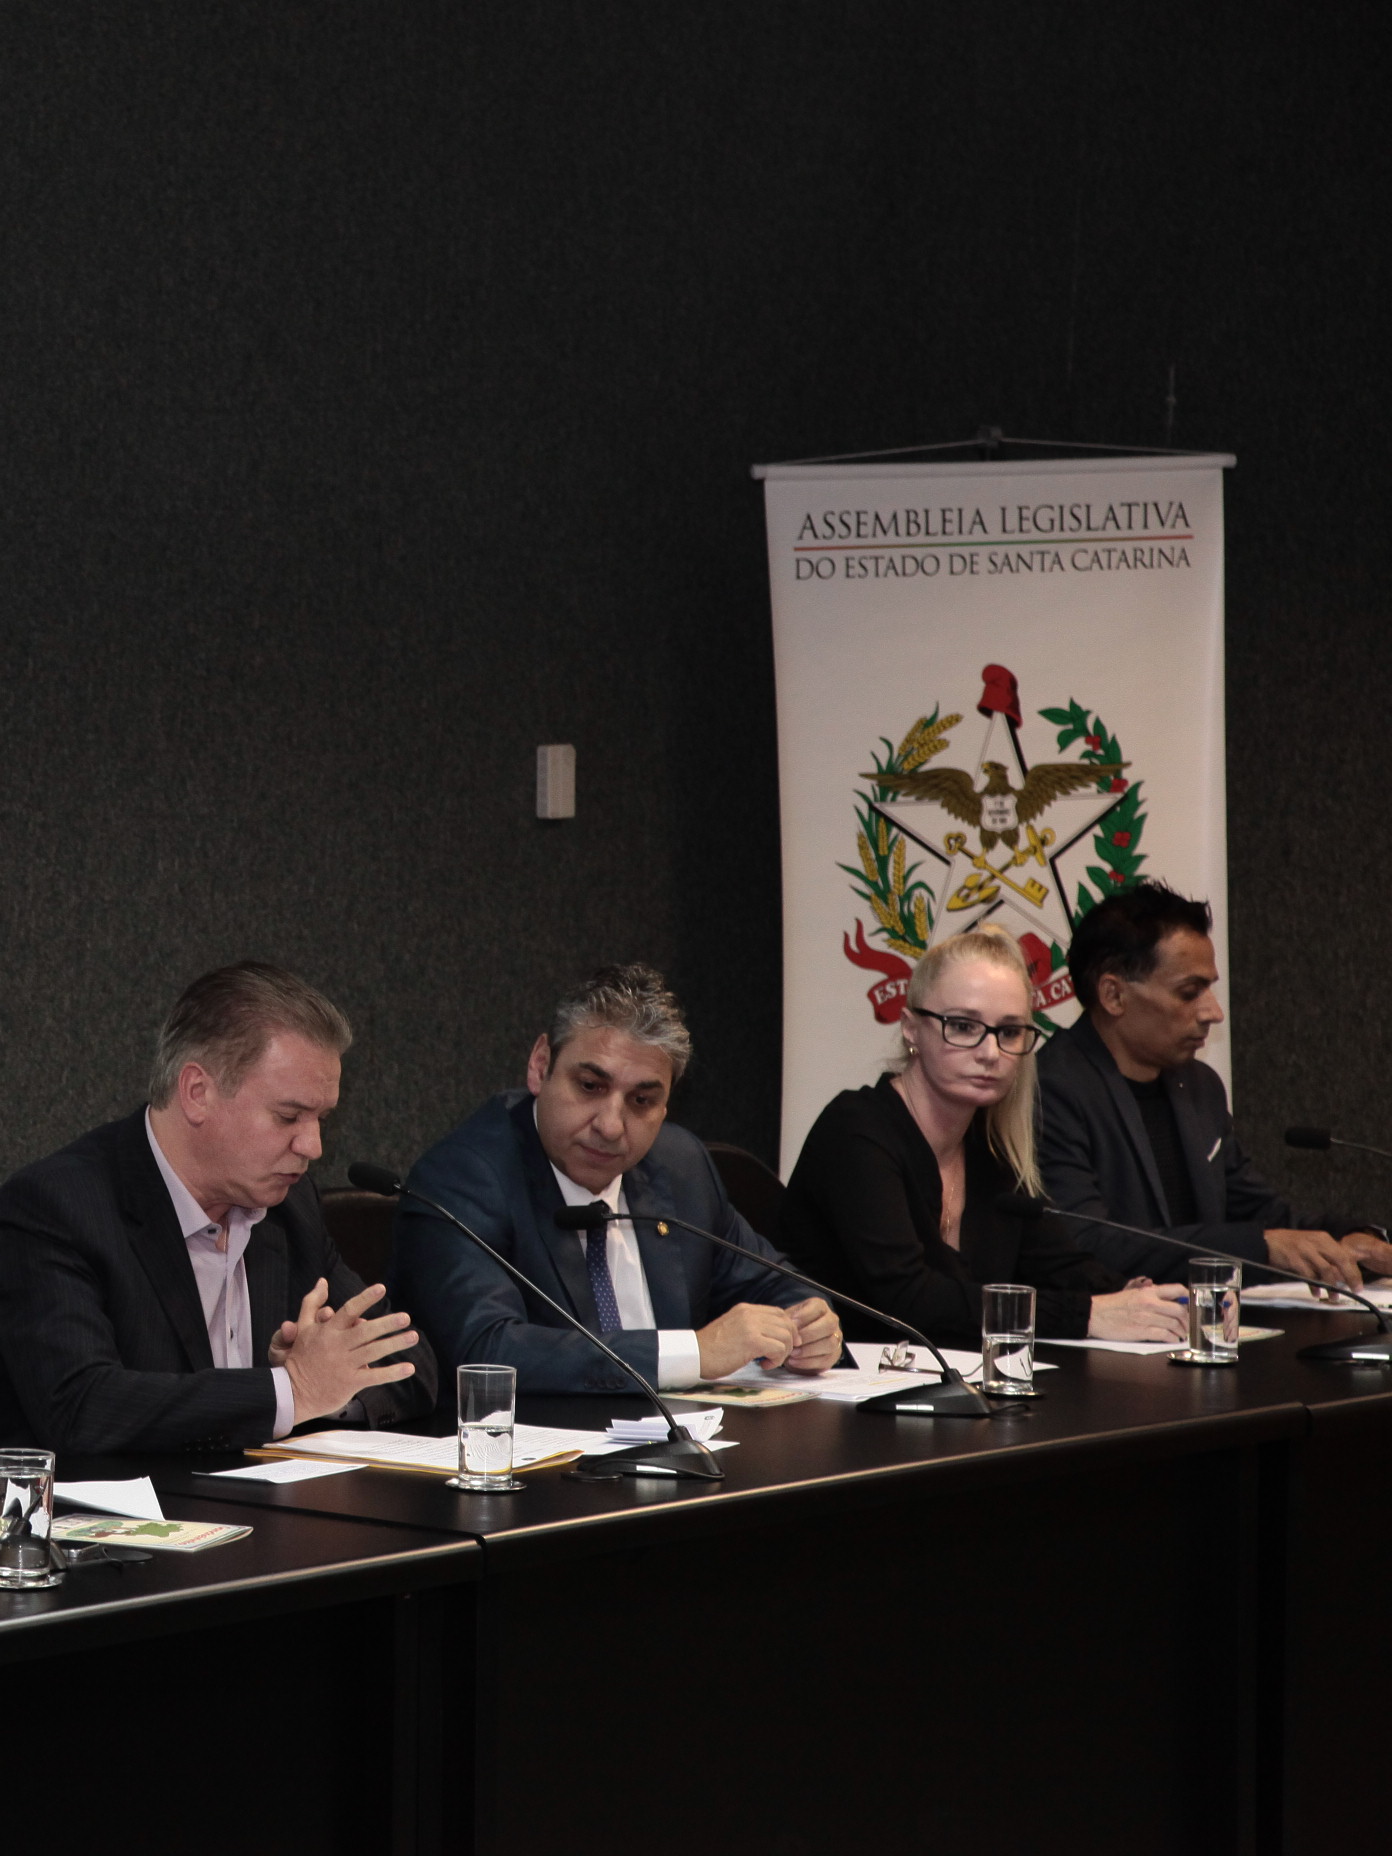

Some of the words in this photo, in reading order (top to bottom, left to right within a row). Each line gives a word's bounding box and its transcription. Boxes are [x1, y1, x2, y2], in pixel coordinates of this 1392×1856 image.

[797, 507, 989, 541] ASSEMBLEIA
[1000, 502, 1191, 534] LEGISLATIVA
[795, 556, 836, 581] DO
[845, 553, 941, 579] ESTADO
[949, 552, 980, 576] DE
[987, 550, 1065, 575] SANTA
[1071, 545, 1192, 572] CATARINA
